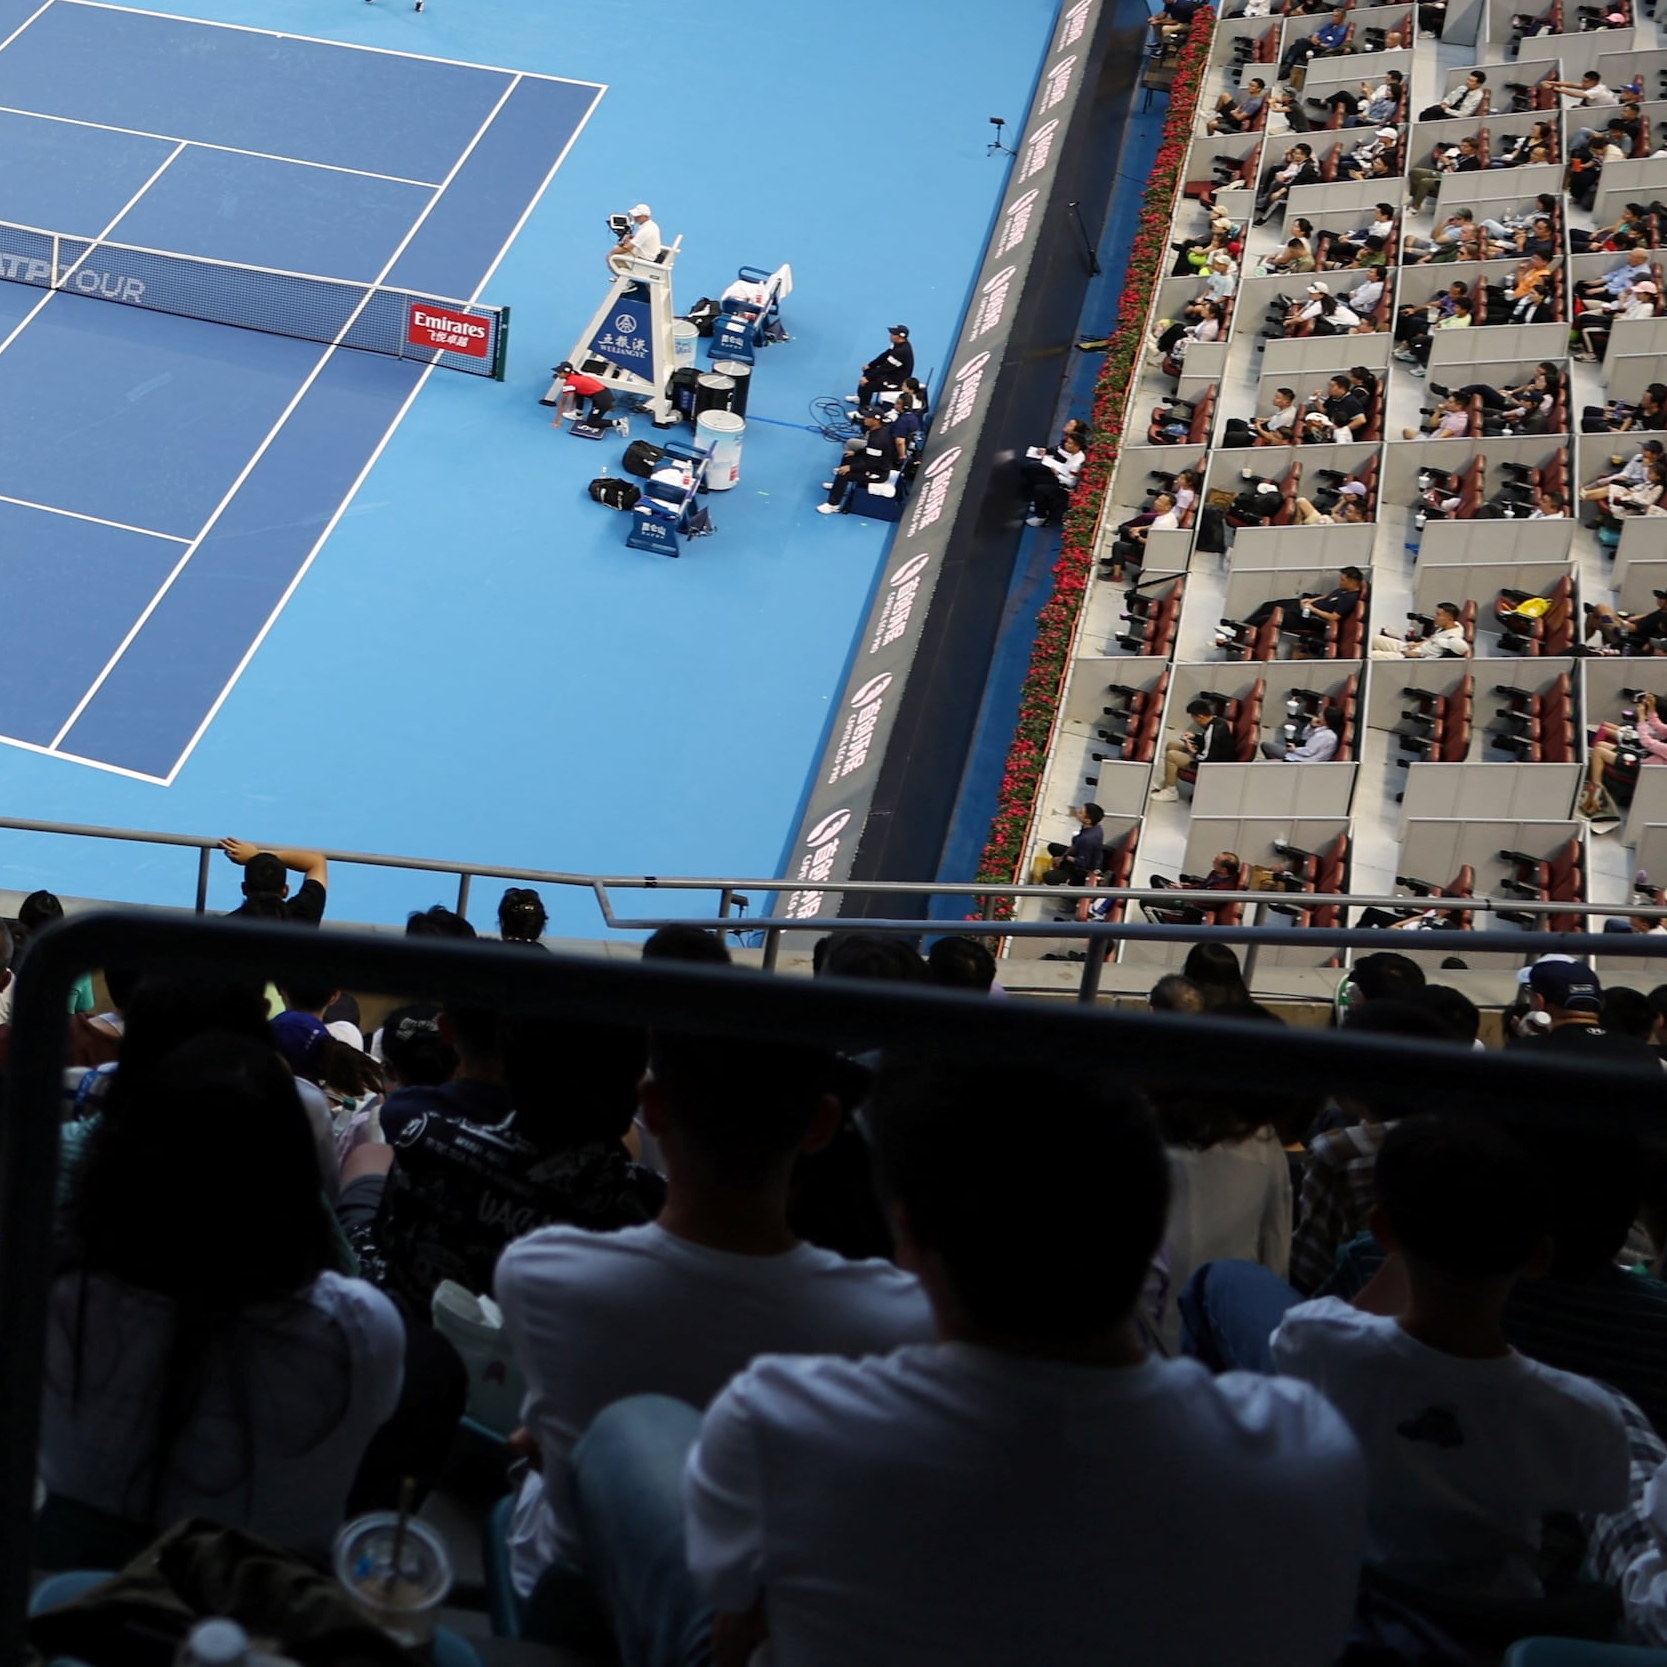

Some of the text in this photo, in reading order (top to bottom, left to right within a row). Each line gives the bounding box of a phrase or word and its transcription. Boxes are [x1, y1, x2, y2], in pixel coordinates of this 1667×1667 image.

[54, 263, 148, 304] TOUR
[413, 310, 486, 339] Emirates
[599, 343, 647, 359] WULIANGYE
[881, 576, 922, 647] 首创环保
[840, 697, 882, 775] 首创环保
